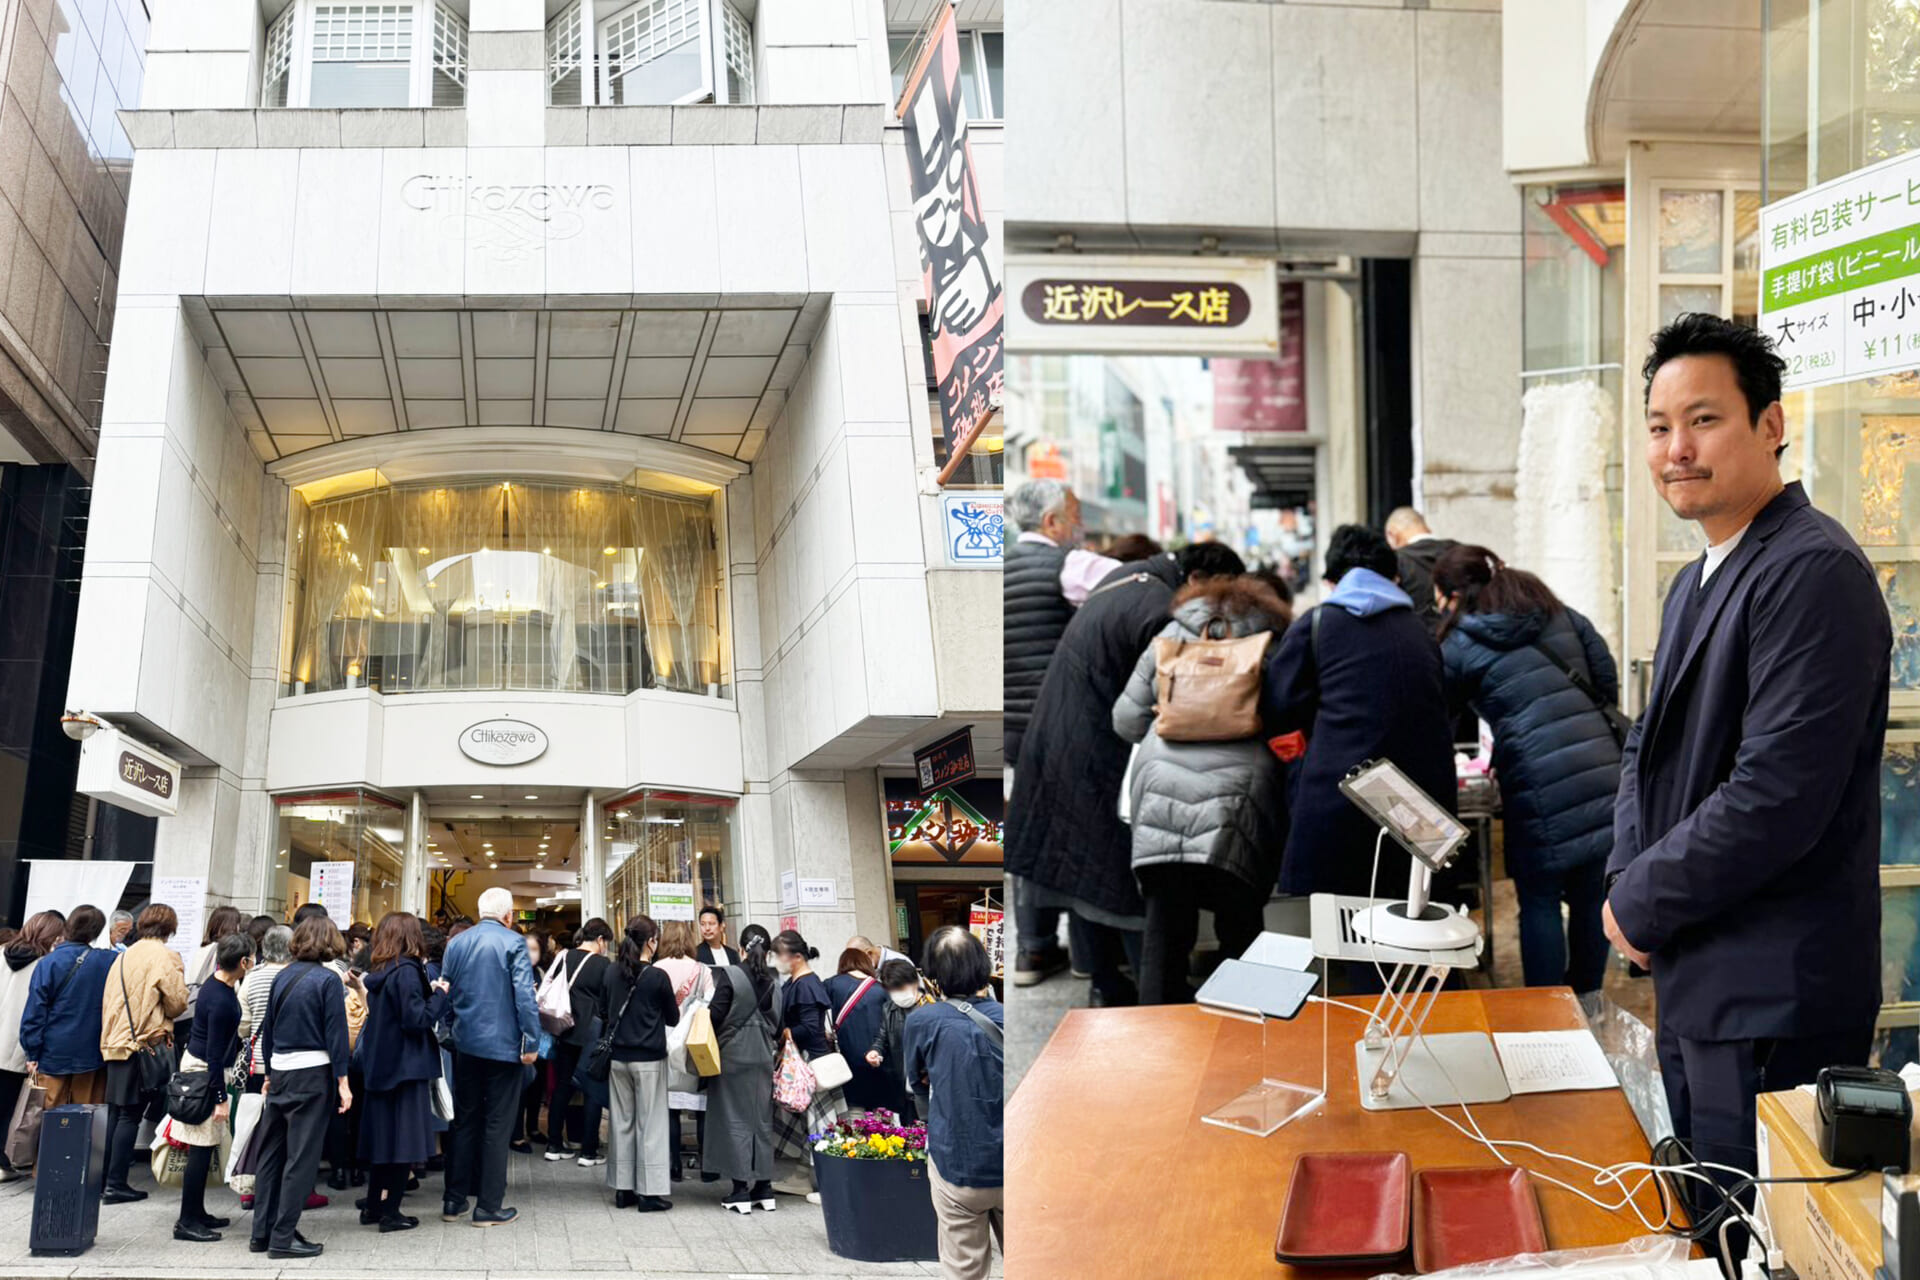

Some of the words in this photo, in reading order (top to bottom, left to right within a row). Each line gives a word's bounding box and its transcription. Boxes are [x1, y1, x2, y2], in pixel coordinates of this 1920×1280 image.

[1043, 285, 1230, 323] 近沢レース店
[123, 757, 169, 794] 近沢レース店
